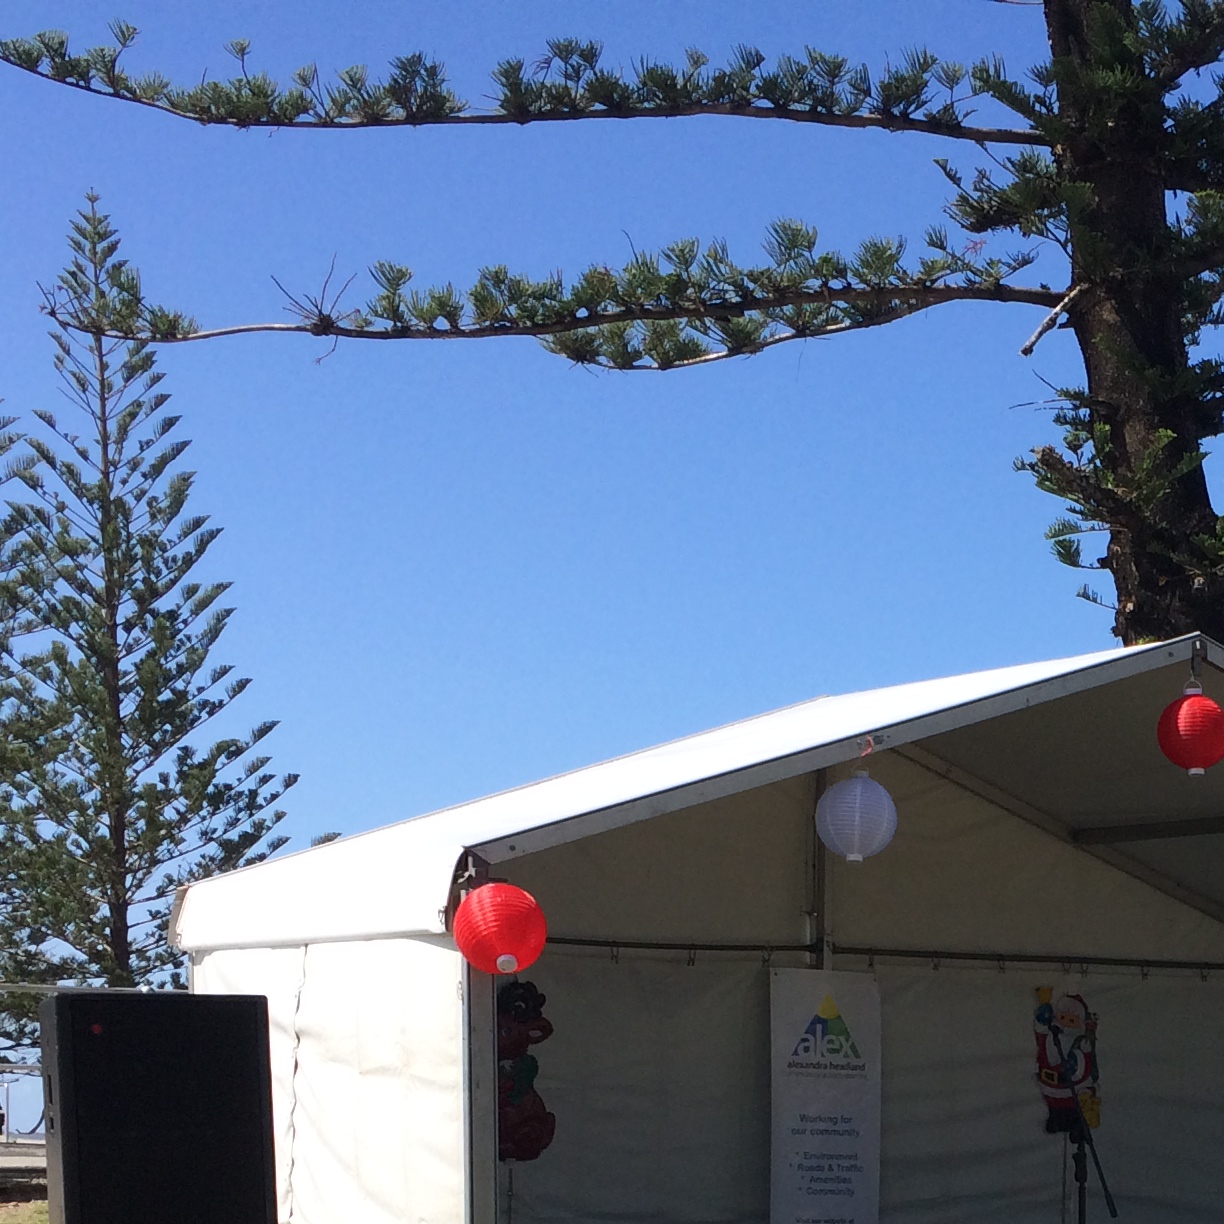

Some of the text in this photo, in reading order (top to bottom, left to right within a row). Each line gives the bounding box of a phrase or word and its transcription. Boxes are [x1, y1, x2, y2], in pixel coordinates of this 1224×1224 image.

[799, 1114, 853, 1126] Working for
[791, 1127, 860, 1138] our community
[803, 1151, 858, 1160] Environment
[806, 1187, 855, 1197] Community
